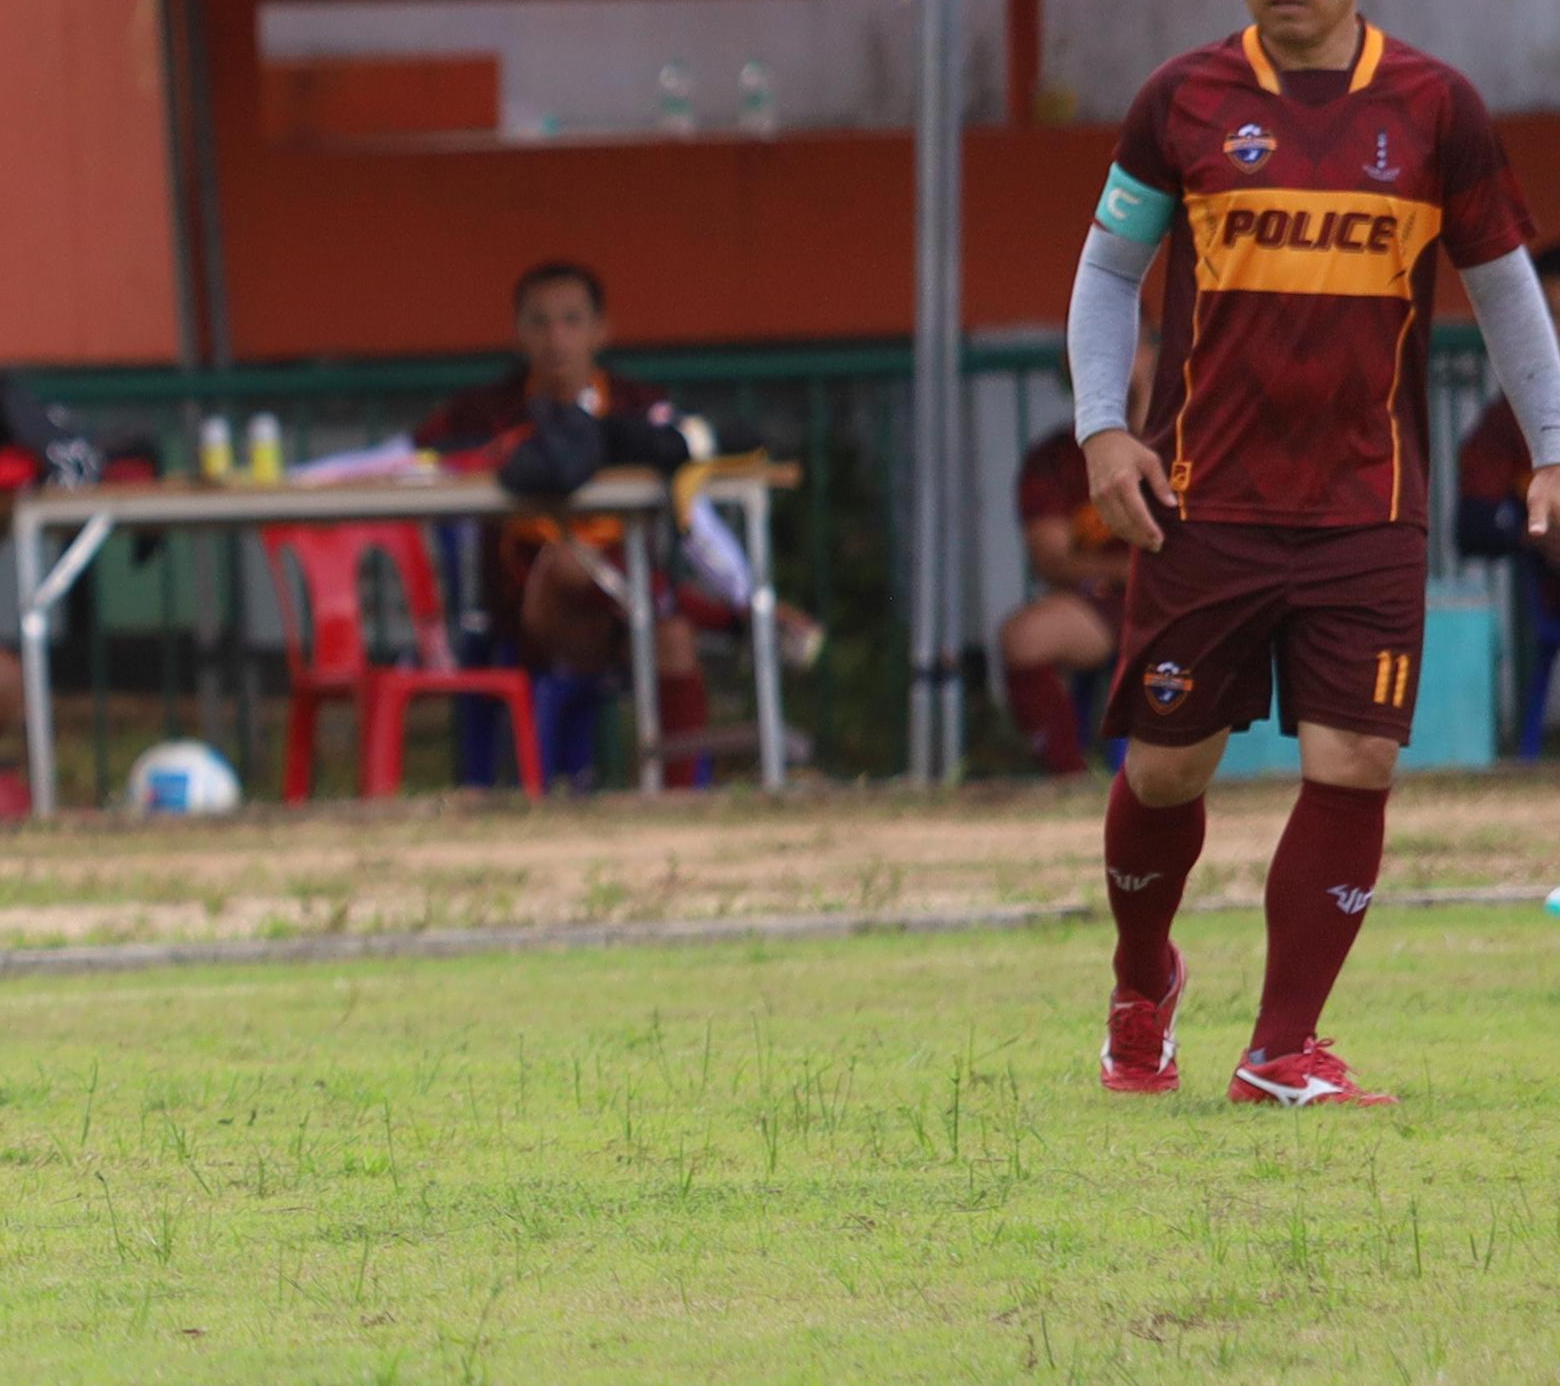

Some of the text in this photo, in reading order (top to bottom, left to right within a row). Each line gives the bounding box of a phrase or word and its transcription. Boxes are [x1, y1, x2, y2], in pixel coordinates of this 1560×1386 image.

[1107, 187, 1140, 220] C
[1223, 209, 1398, 253] POLICE
[1374, 650, 1409, 707] 11
